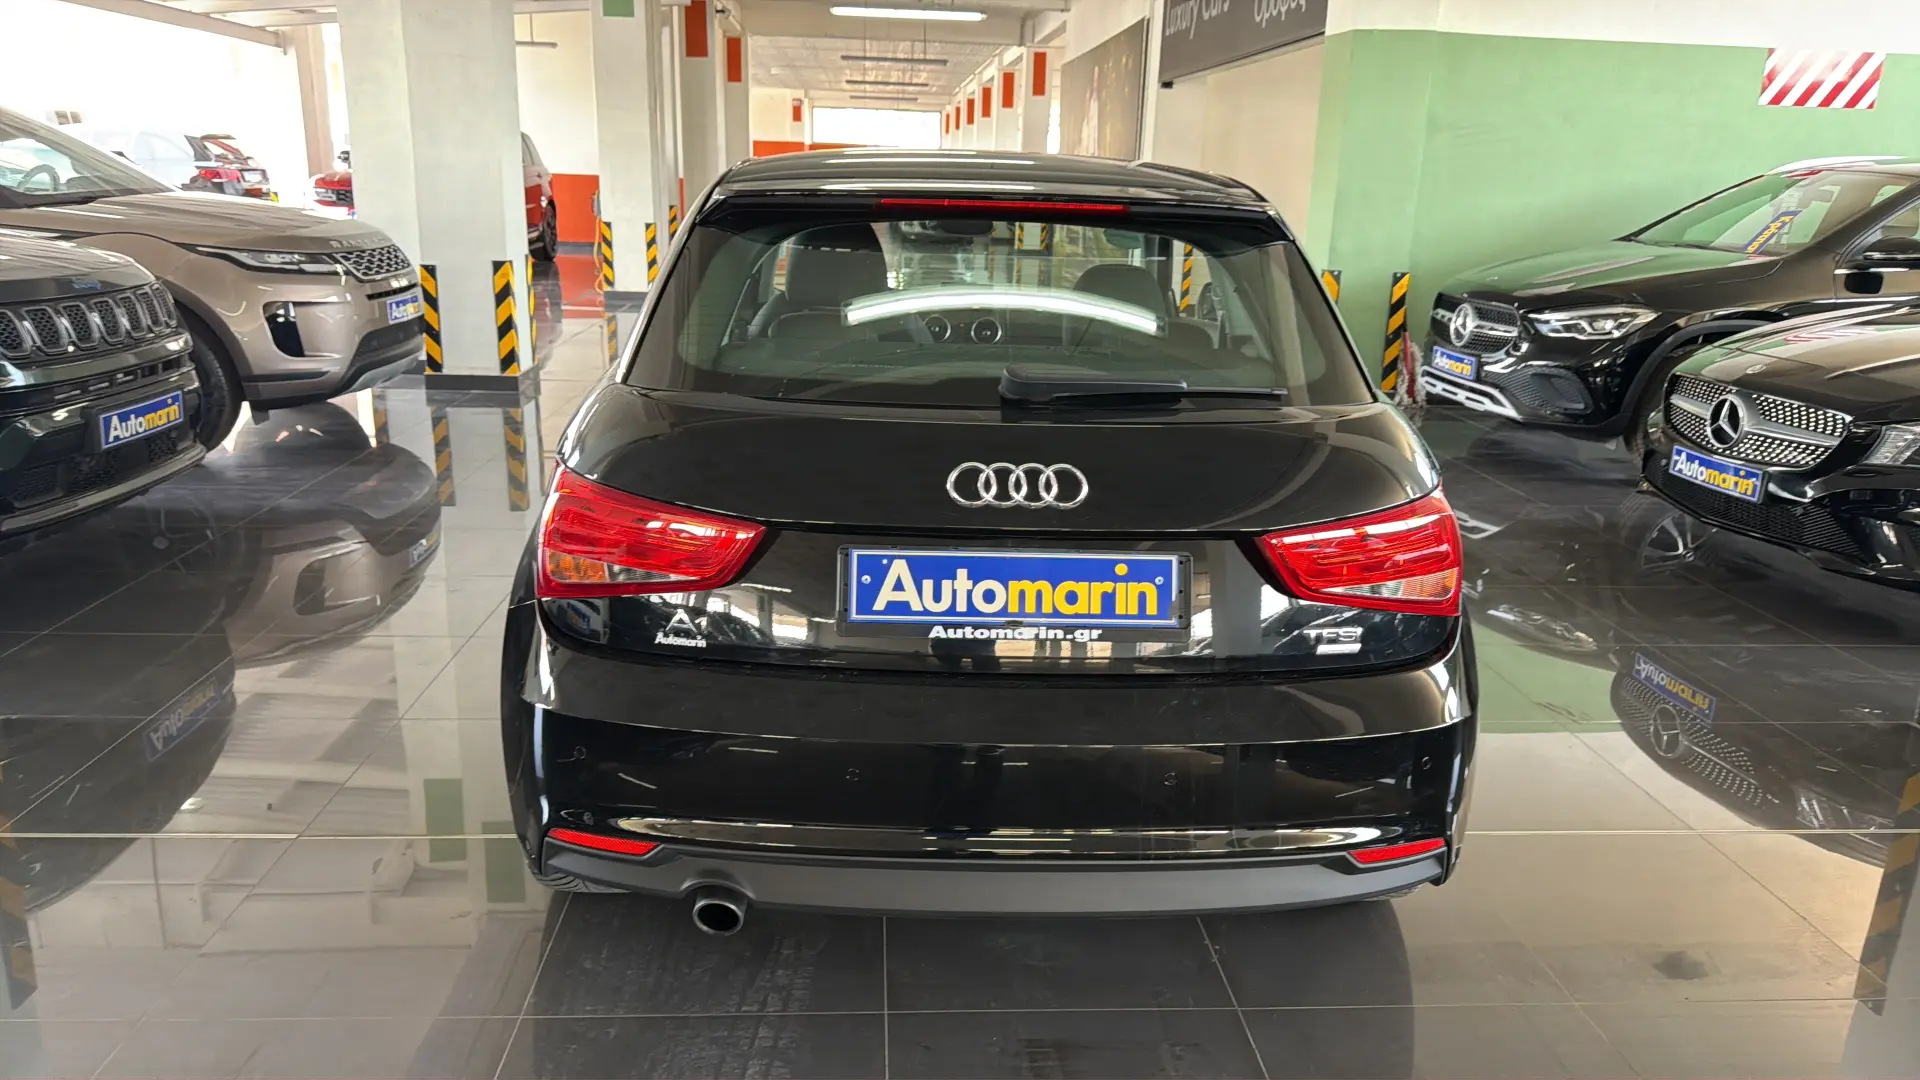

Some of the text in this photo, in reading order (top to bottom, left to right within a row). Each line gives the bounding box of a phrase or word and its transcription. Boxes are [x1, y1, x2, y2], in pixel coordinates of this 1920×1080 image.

[1165, 0, 1200, 39] Luxury
[108, 398, 180, 442] Automarin
[1674, 451, 1754, 496] Automarin
[872, 558, 1158, 615] Automarin
[928, 625, 1103, 640] Automarin.gr
